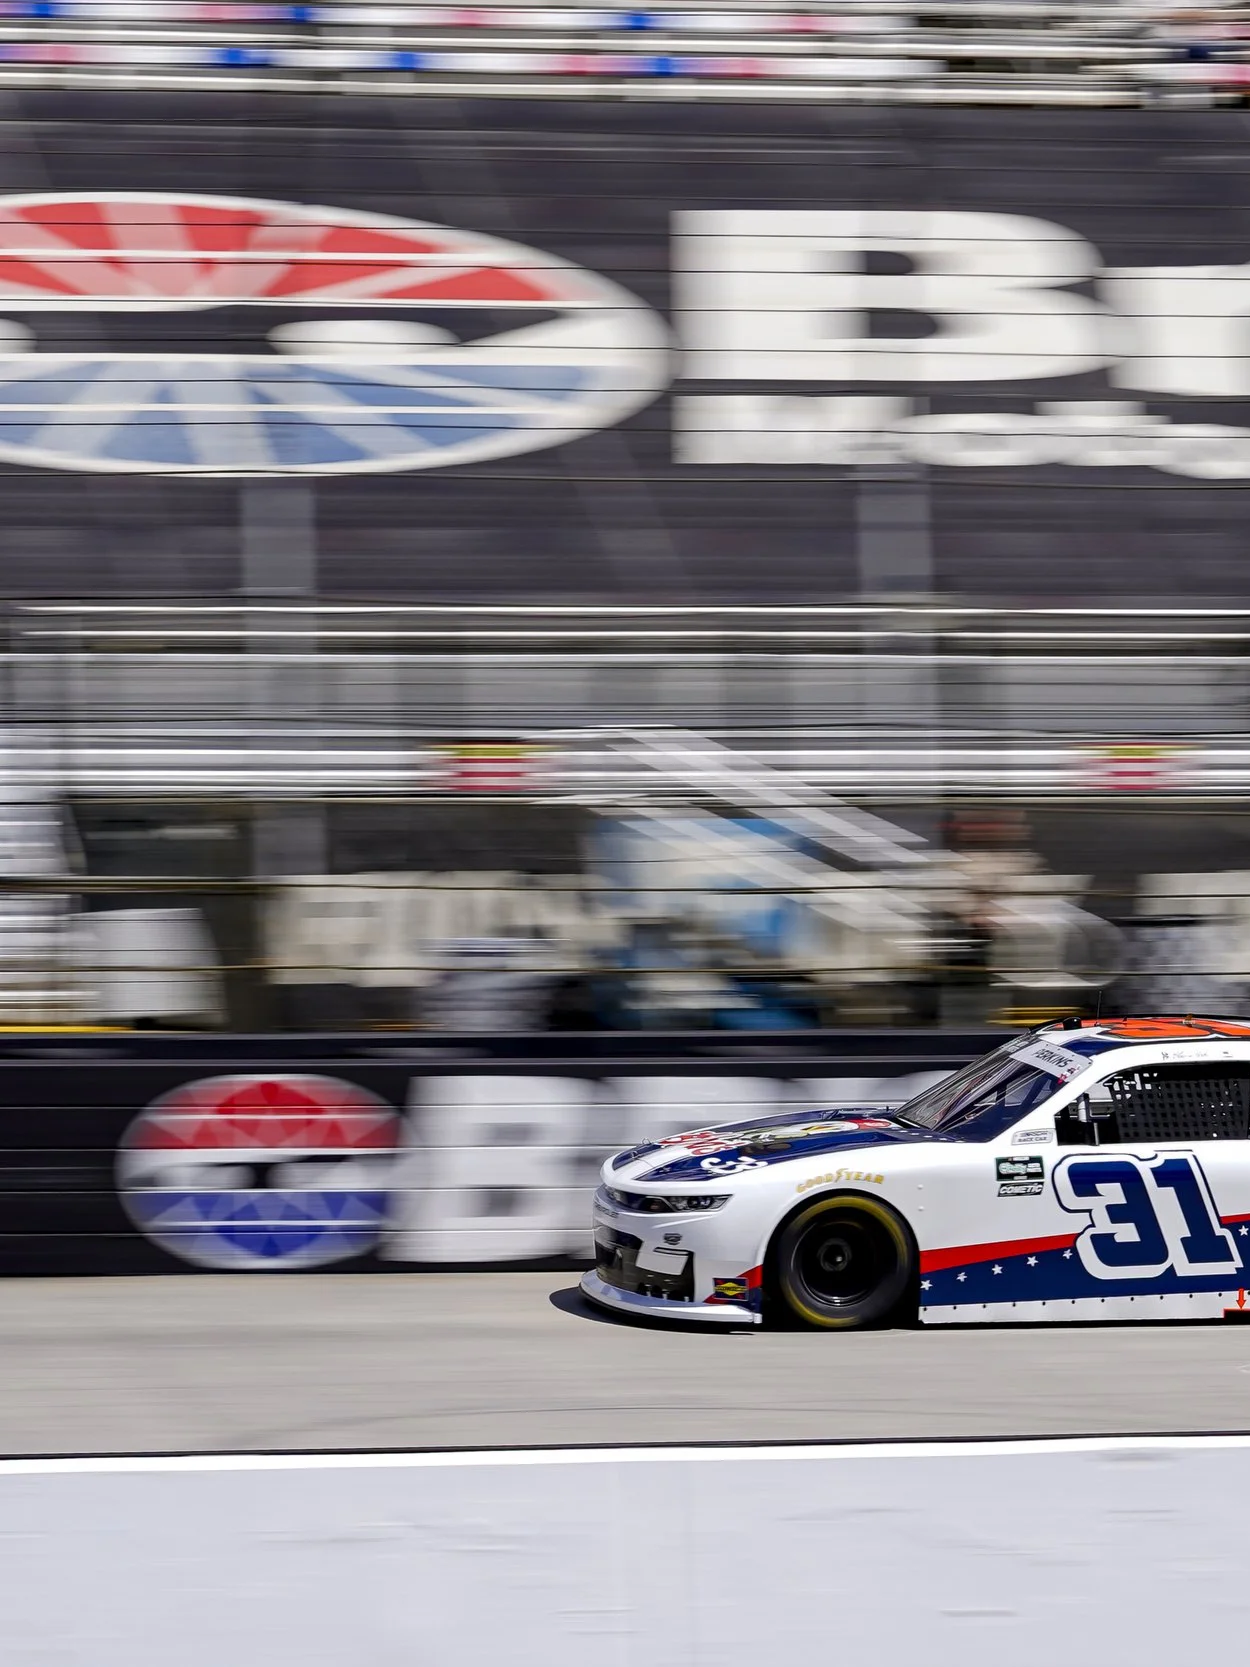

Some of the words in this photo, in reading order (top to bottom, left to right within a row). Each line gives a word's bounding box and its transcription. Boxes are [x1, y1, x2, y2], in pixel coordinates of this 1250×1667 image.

[1033, 1048, 1073, 1068] PERKINS
[796, 1168, 885, 1193] GOODYEAR
[1055, 1152, 1242, 1279] 31
